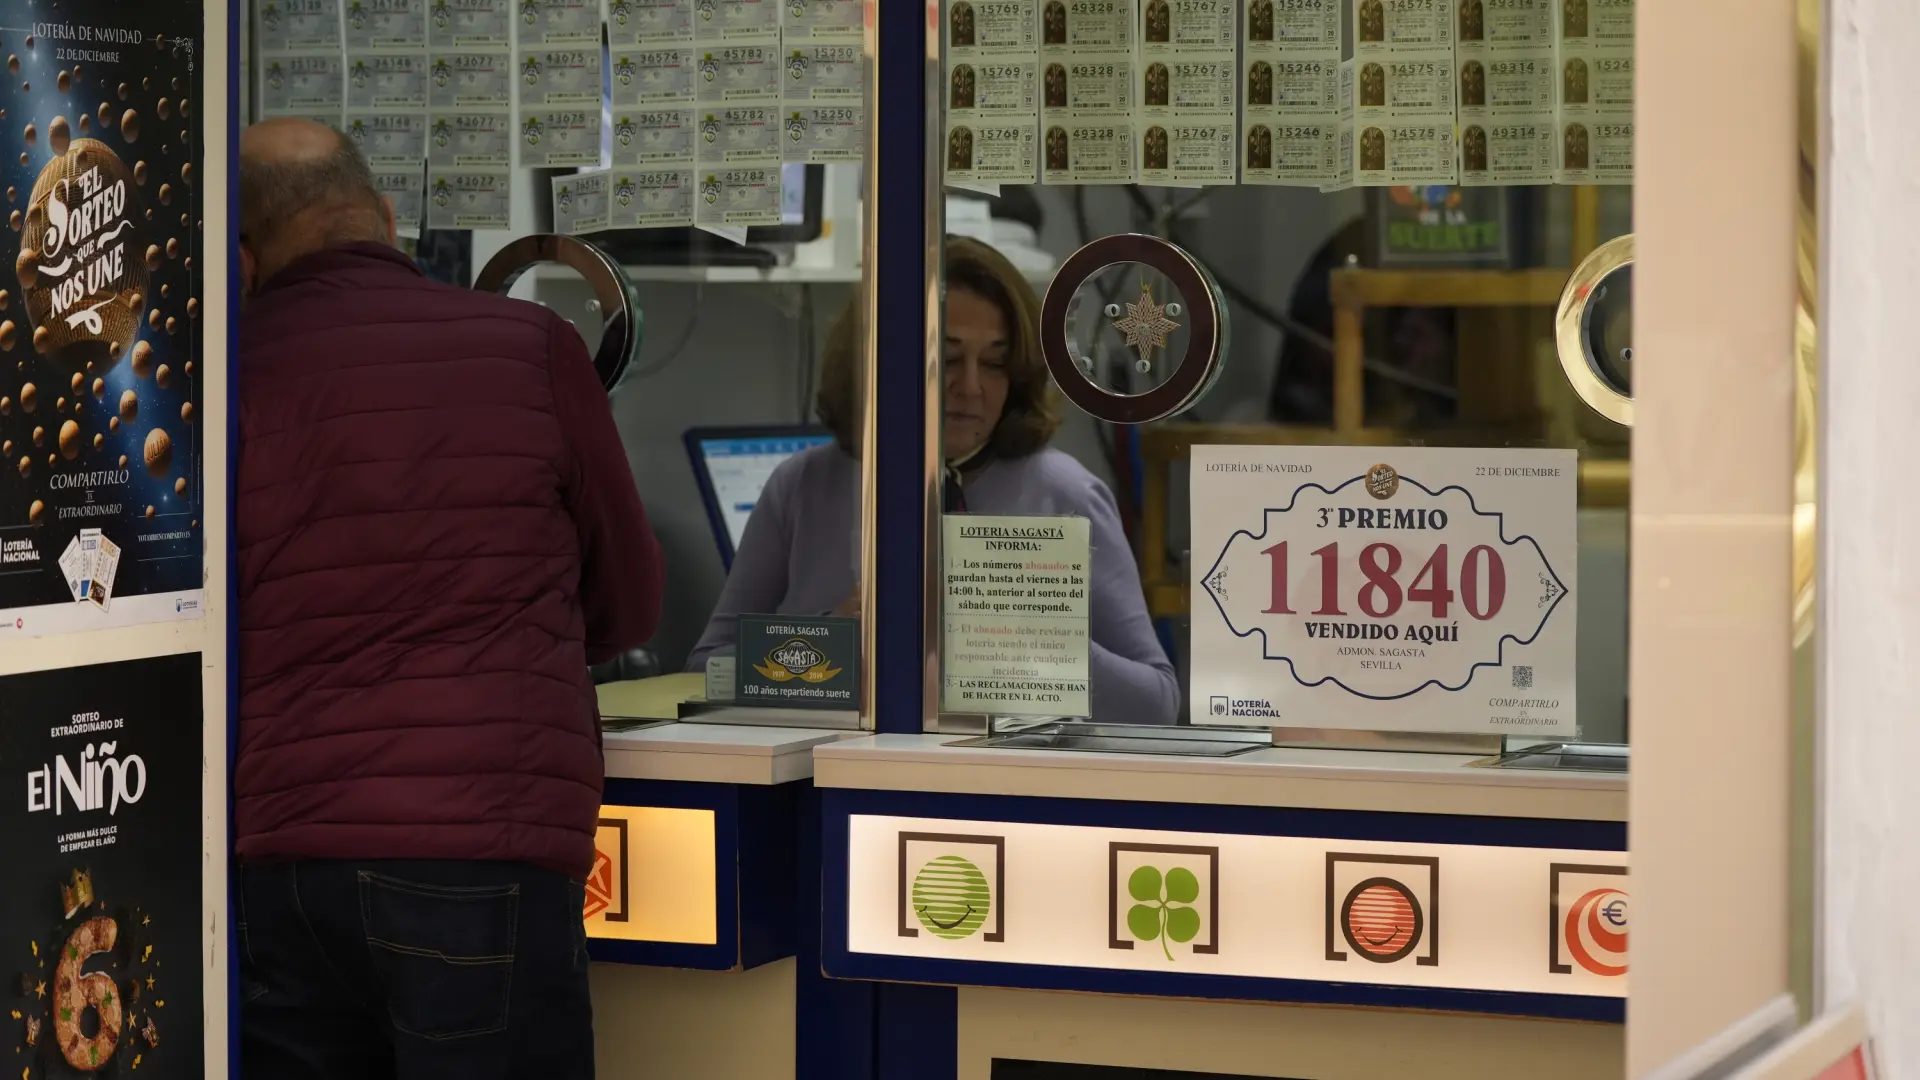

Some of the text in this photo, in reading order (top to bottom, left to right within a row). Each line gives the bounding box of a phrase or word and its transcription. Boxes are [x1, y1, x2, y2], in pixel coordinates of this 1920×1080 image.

[980, 5, 1020, 14] 15769
[1071, 3, 1113, 13] 49328
[1176, 2, 1216, 12] 15767
[1279, 0, 1321, 9] 15246
[1391, 0, 1433, 9] 14575
[32, 21, 142, 44] LOTERÍA DE NAVIDAD
[56, 48, 120, 63] 22 DE DICIEMBRE
[640, 52, 678, 64] 36574
[724, 49, 762, 59] 45782
[814, 48, 853, 58] 15250
[455, 57, 493, 67] 43677
[1491, 62, 1534, 72] 49314
[1596, 61, 1631, 70] 1524
[981, 66, 1020, 76] 15769
[1071, 66, 1113, 75] 49328
[1176, 65, 1216, 74] 15767
[1279, 64, 1321, 73] 15246
[1391, 64, 1434, 73] 14575
[641, 112, 679, 124] 36574
[725, 110, 764, 121] 45782
[813, 110, 853, 120] 15250
[979, 129, 1019, 139] 15769
[1073, 129, 1113, 138] 49328
[1175, 128, 1216, 138] 15767
[1278, 127, 1320, 137] 15246
[1391, 128, 1435, 138] 14575
[1491, 127, 1535, 137] 49314
[1596, 126, 1631, 136] 1524
[79, 165, 103, 198] EL
[378, 176, 407, 186] 4148
[456, 176, 494, 187] 43677
[639, 173, 679, 185] 36574
[725, 171, 765, 181] 45782
[43, 178, 126, 258] SORTEO
[77, 241, 95, 264] QUE
[50, 242, 124, 319] NOS UNE
[1206, 461, 1313, 474] LOTERÍA DE NAVIDAD
[1475, 466, 1561, 478] 22 DE DICIEMBRE
[50, 469, 130, 490] COMPARTIRLO
[58, 503, 122, 520] EXTRAORDINARIO
[1338, 507, 1448, 530] PREMIO
[960, 527, 1009, 537] LOTERIA
[3, 538, 33, 552] LOTERÍA
[985, 541, 1042, 551] INFORMA:
[3, 550, 40, 562] NACIONAL
[963, 559, 980, 569] Los
[983, 560, 1023, 569] números
[1072, 563, 1082, 571] se
[947, 573, 986, 584] guardan
[989, 574, 1013, 583] hasta
[1016, 574, 1024, 584] el
[1026, 575, 1060, 584] viernes
[1070, 575, 1084, 585] las
[1260, 541, 1506, 621] 11840
[949, 586, 1084, 599] 14:00 h, anterior al sorteo del
[958, 600, 1073, 613] sábado que corresponde.
[766, 625, 829, 636] LOTERÍA SAGASTA
[961, 624, 971, 633] El
[1015, 625, 1036, 636] debe
[1039, 627, 1071, 636] revisar
[1074, 628, 1085, 637] su
[1305, 621, 1459, 646] VENDIDO AQUÍ
[1029, 640, 1038, 649] el
[777, 649, 816, 664] SAGASTA
[1336, 647, 1426, 658] ADMON. SAGASTA
[955, 652, 1078, 666] responsable ante cualquier
[1360, 660, 1402, 670] SEVILLA
[992, 667, 1039, 677] incidencia
[744, 684, 850, 699] 100 años repartiendo suerte
[959, 680, 976, 689] LAS
[978, 680, 1053, 691] RECLAMACIONES
[1055, 683, 1065, 691] SE
[1067, 684, 1086, 692] HAN
[976, 692, 1007, 701] HACER
[1009, 693, 1020, 701] EN
[1022, 693, 1033, 701] EL
[1036, 694, 1062, 703] ACTO.
[1488, 697, 1559, 709] COMPARTIRLO
[1232, 698, 1271, 709] LOTERÍA
[72, 711, 100, 724] SORTEO
[1232, 709, 1281, 718] NACIONAL
[1489, 716, 1558, 726] EXTRAORDINARIO
[51, 718, 124, 738] EXTRAORDINARIO DE
[28, 740, 147, 816] El Niño
[57, 825, 118, 843] LA FORMA MÁS DULCE
[60, 835, 116, 853] DE EMPEZAR EL AÑO
[53, 916, 122, 1071] 6
